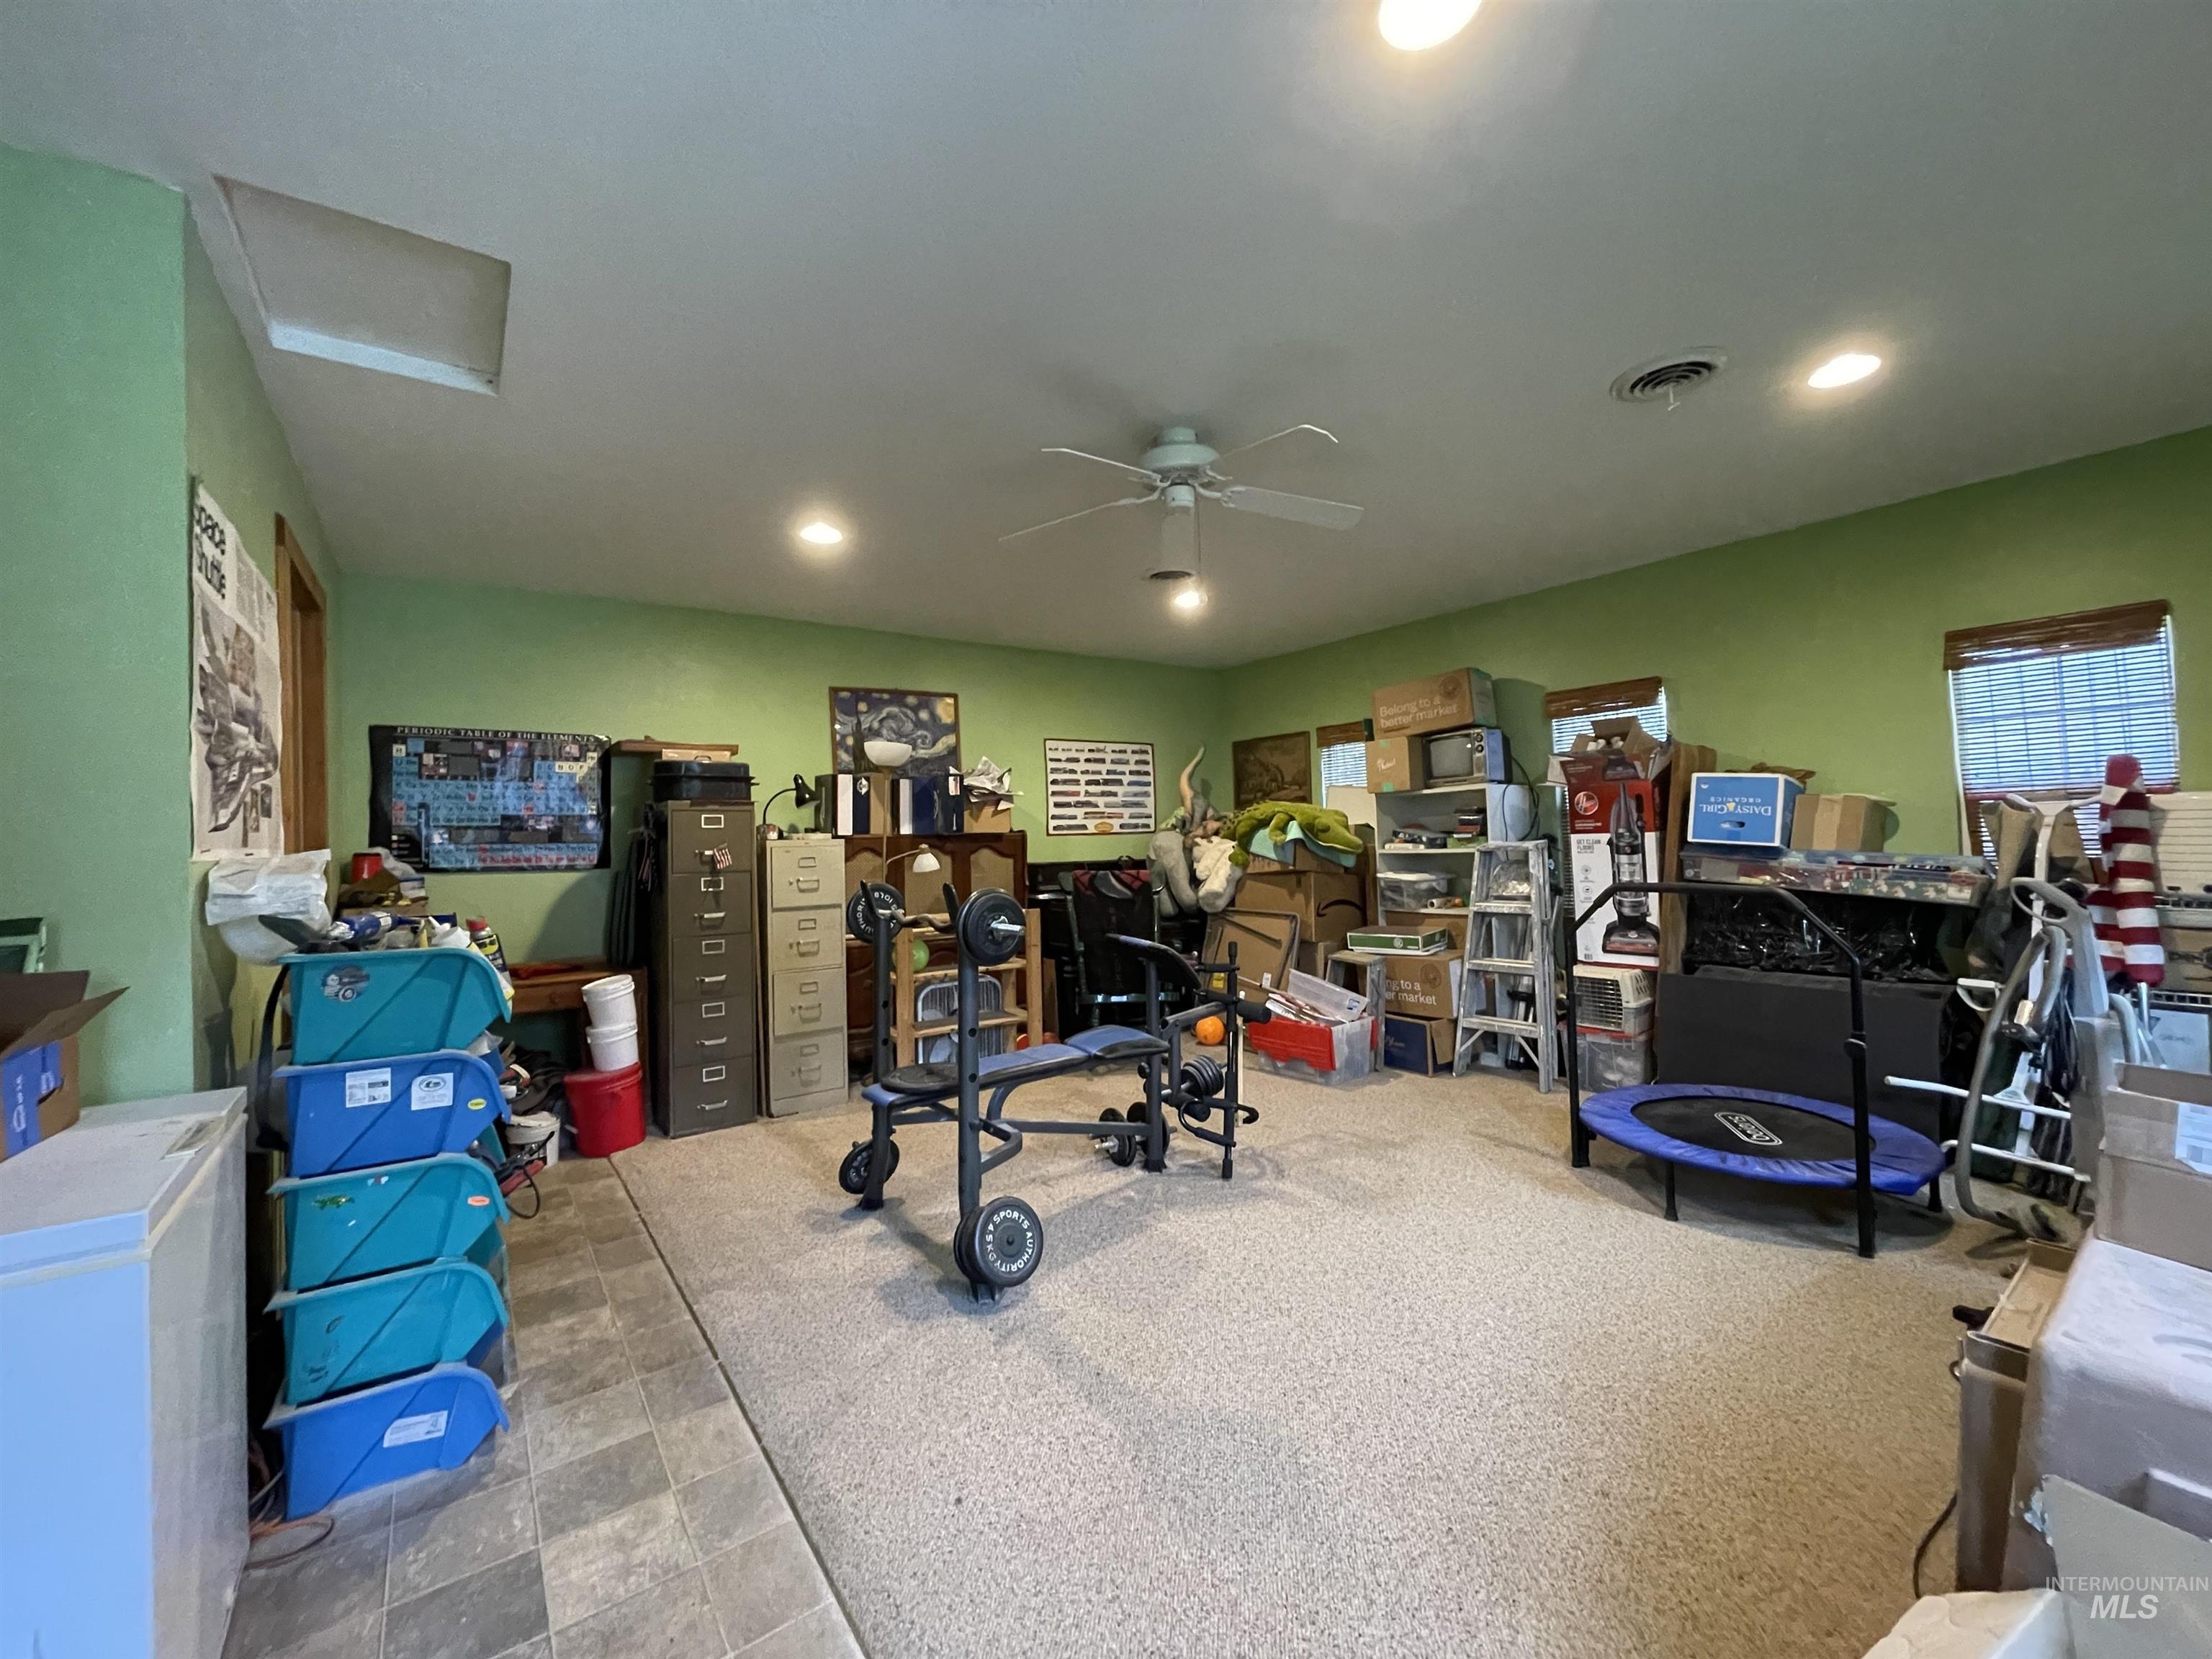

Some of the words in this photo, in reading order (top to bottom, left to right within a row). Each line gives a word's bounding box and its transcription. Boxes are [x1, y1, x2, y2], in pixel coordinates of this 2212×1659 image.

[1380, 701, 1418, 717] Belong
[1419, 698, 1431, 709] to
[1433, 696, 1441, 705] a
[1380, 715, 1413, 728] better
[1416, 703, 1458, 721] market
[397, 727, 456, 735] PERIODIC
[541, 733, 595, 742] ELEMENTS
[1699, 804, 1727, 814] GIRL
[1735, 805, 1771, 816] DAISY
[1401, 980, 1411, 992] to
[1414, 981, 1421, 992] a
[1398, 991, 1438, 1006] market
[993, 1209, 1030, 1230] SPORTS
[994, 1231, 1034, 1272] AUTHORITY
